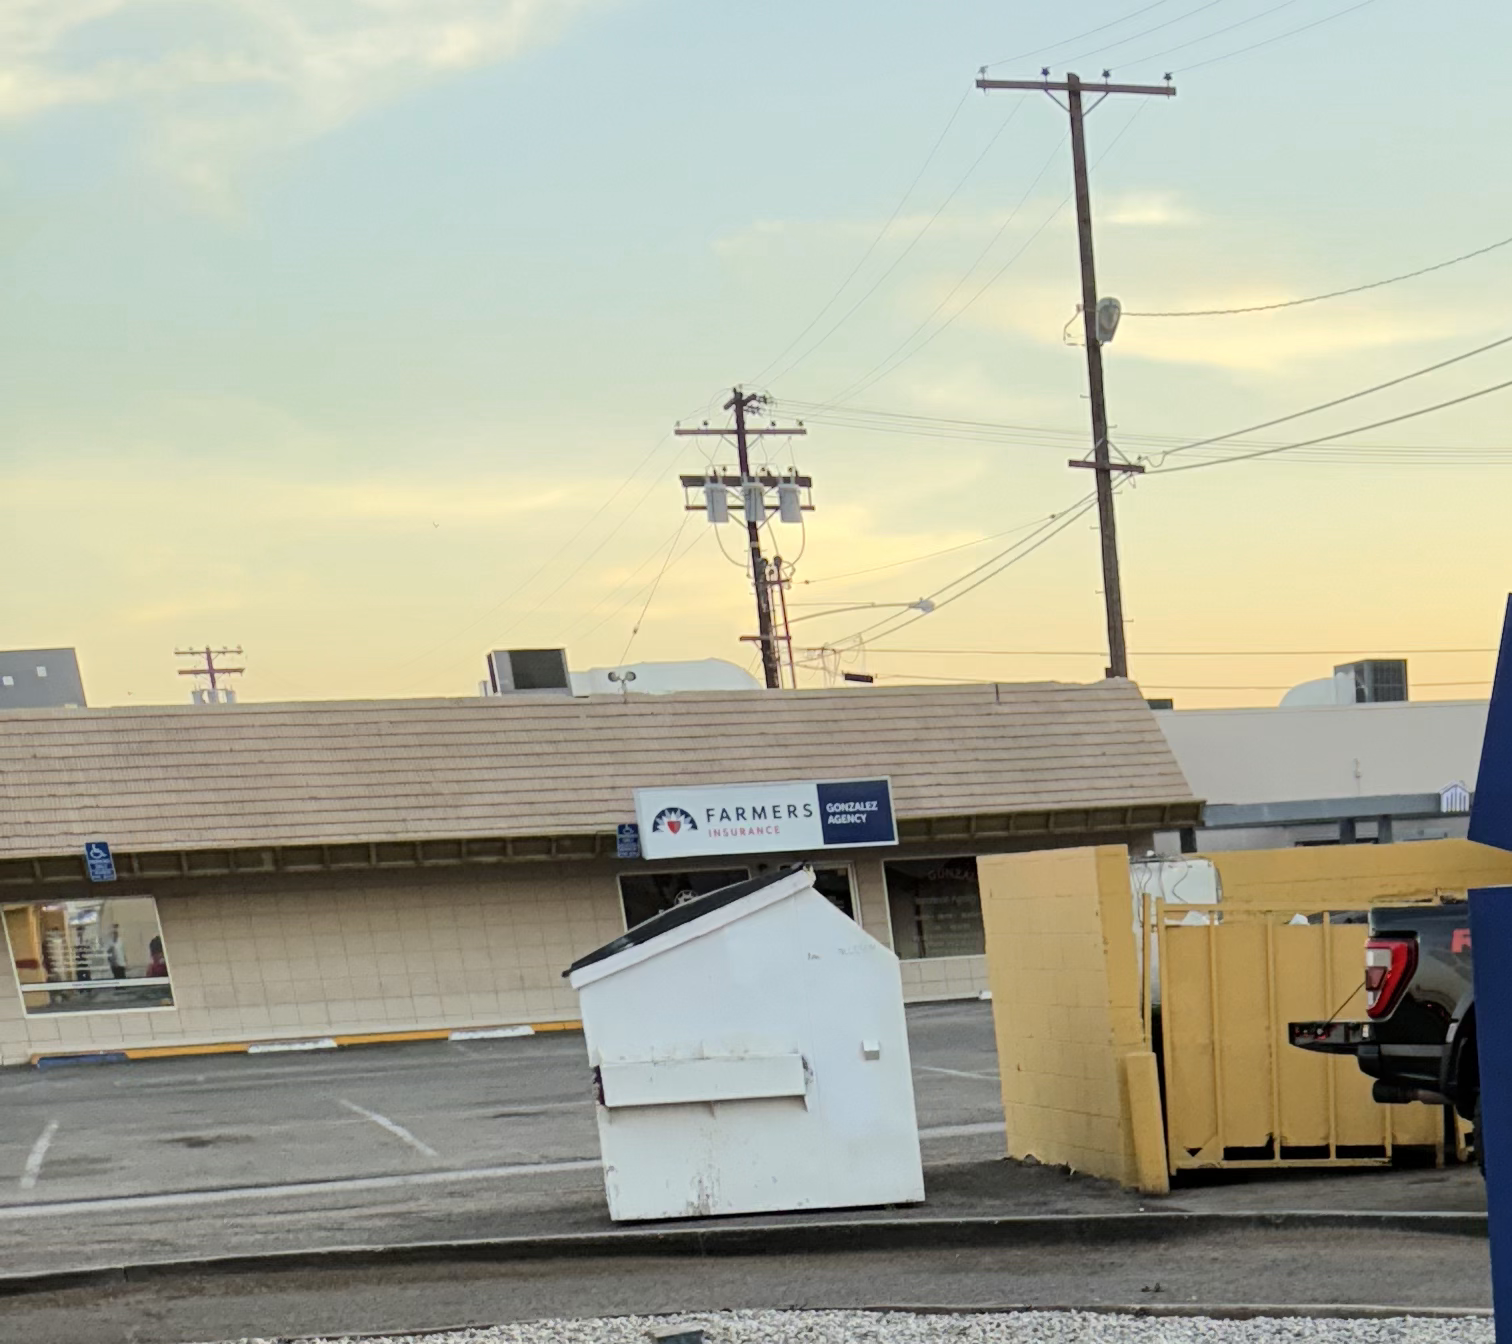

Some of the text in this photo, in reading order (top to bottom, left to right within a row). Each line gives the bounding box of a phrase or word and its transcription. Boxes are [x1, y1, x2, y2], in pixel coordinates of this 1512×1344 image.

[706, 803, 813, 823] FARMERS
[826, 801, 878, 813] GONZALEZ
[827, 813, 867, 825] AGENCY
[708, 825, 781, 838] INSURANCE
